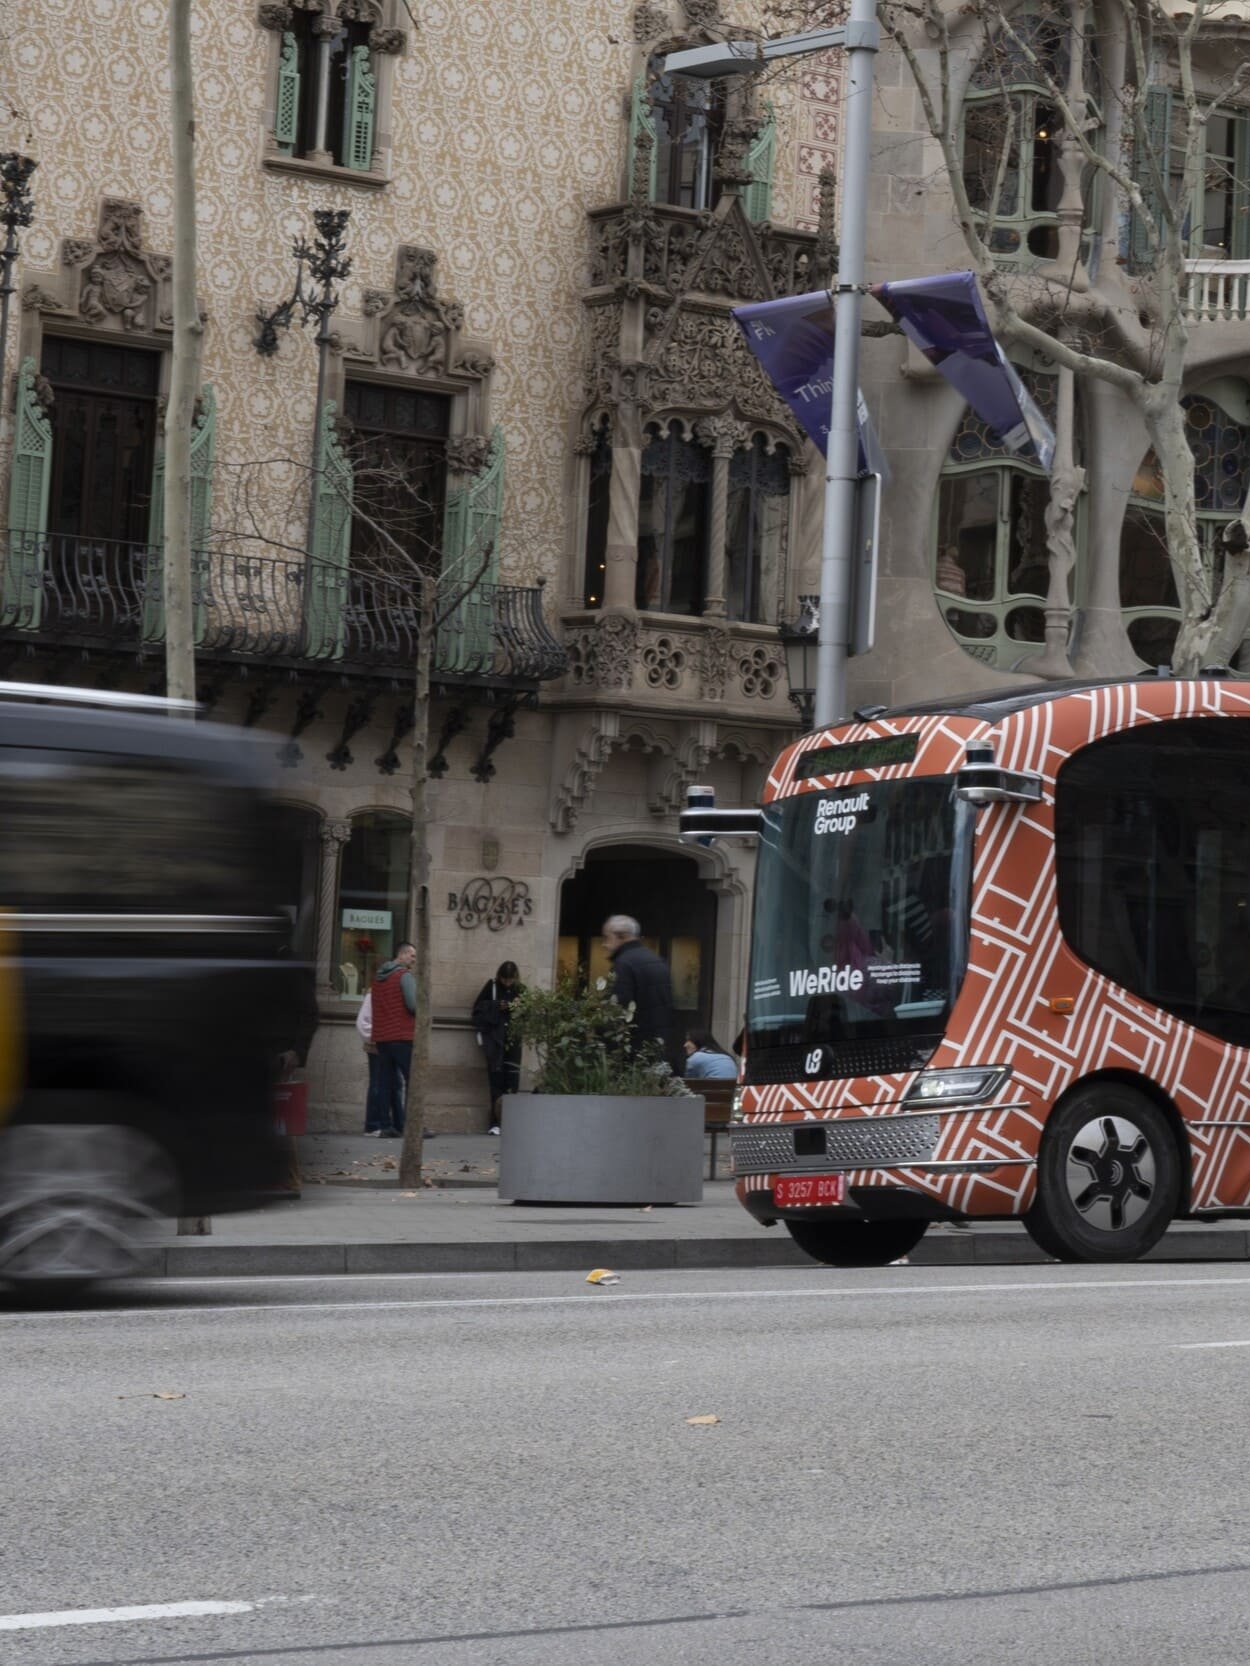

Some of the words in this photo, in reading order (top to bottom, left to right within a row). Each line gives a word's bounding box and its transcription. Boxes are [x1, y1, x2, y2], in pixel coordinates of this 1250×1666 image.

[794, 376, 834, 402] Thin
[816, 793, 870, 817] Renault
[814, 815, 856, 835] Group
[789, 964, 864, 997] WeRide
[776, 1183, 784, 1199] S
[788, 1181, 814, 1198] 3257
